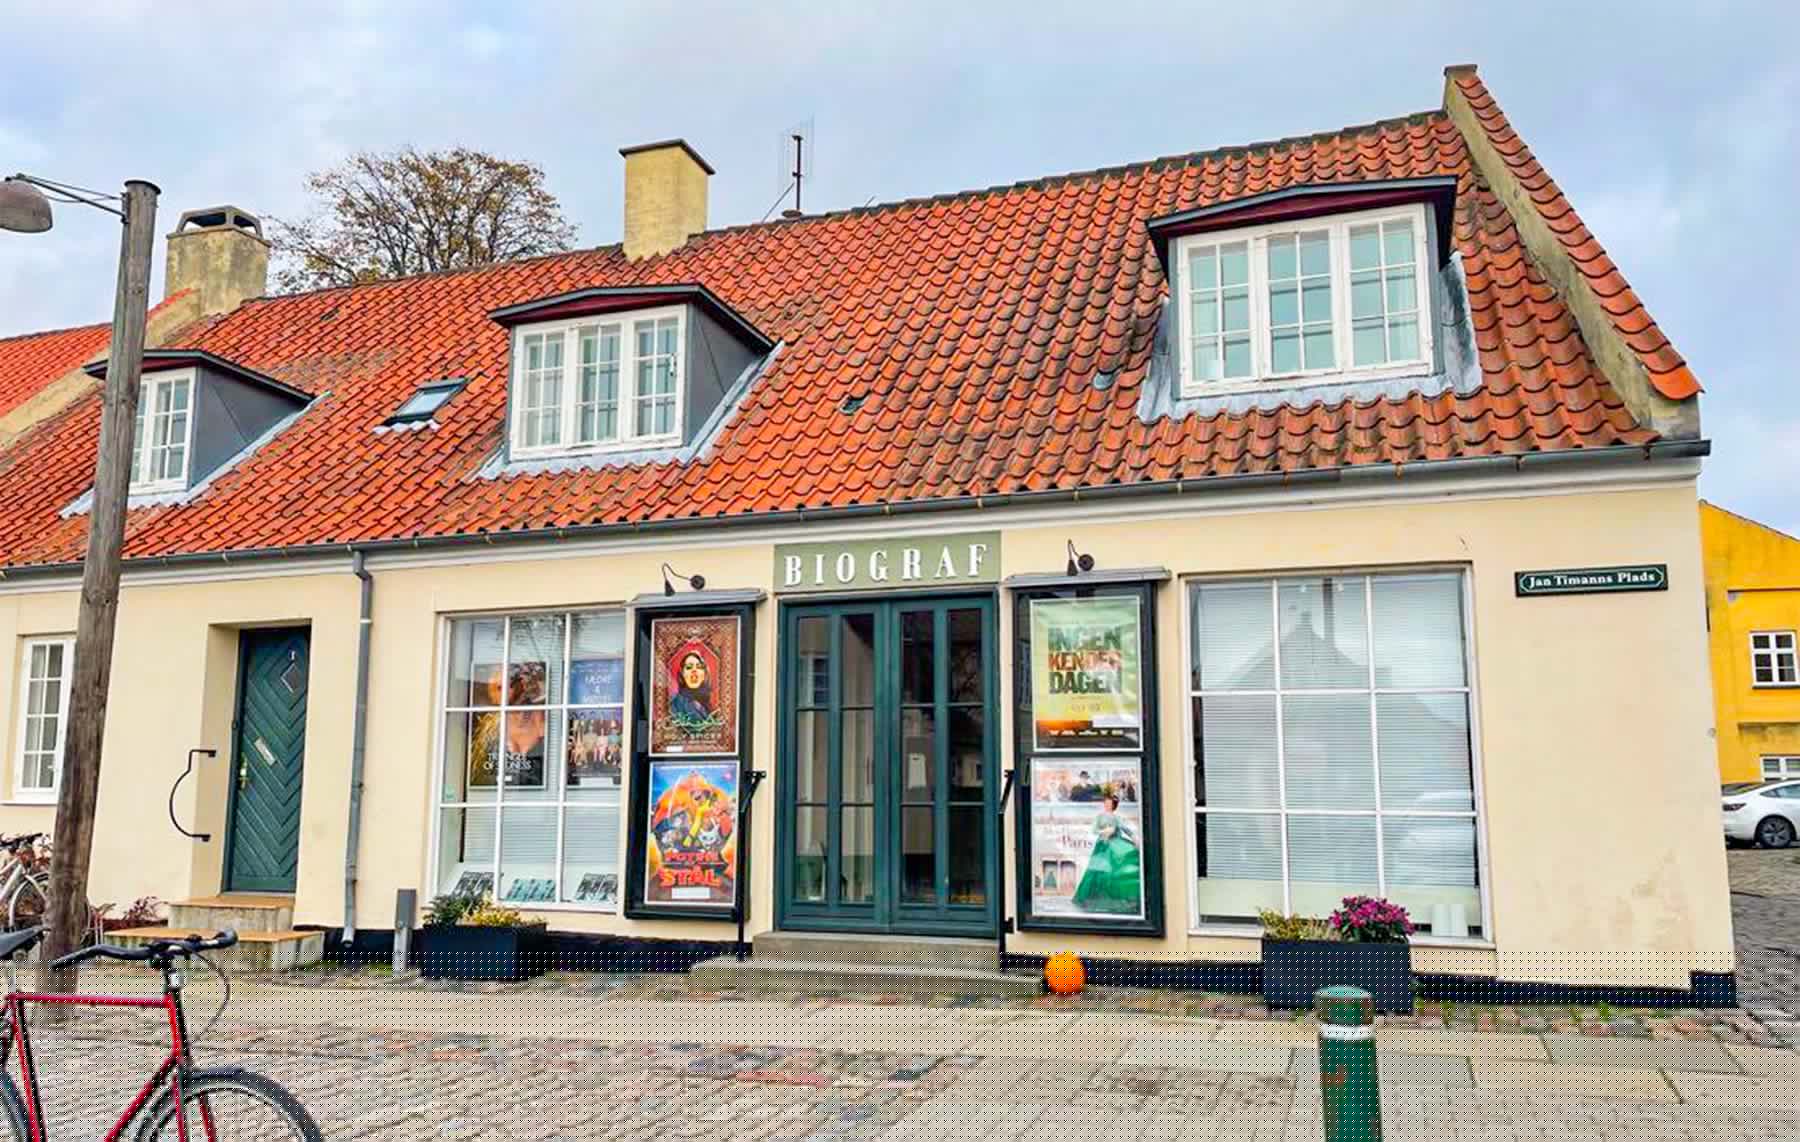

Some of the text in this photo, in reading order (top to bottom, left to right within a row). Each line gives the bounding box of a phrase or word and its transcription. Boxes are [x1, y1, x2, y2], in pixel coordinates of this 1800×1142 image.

[784, 544, 987, 588] BIOGRAF
[1528, 571, 1655, 589] Jan Timanns Plads
[1048, 651, 1121, 671] KENDER
[1048, 672, 1121, 694] DAGEN
[657, 865, 722, 888] STÅL
